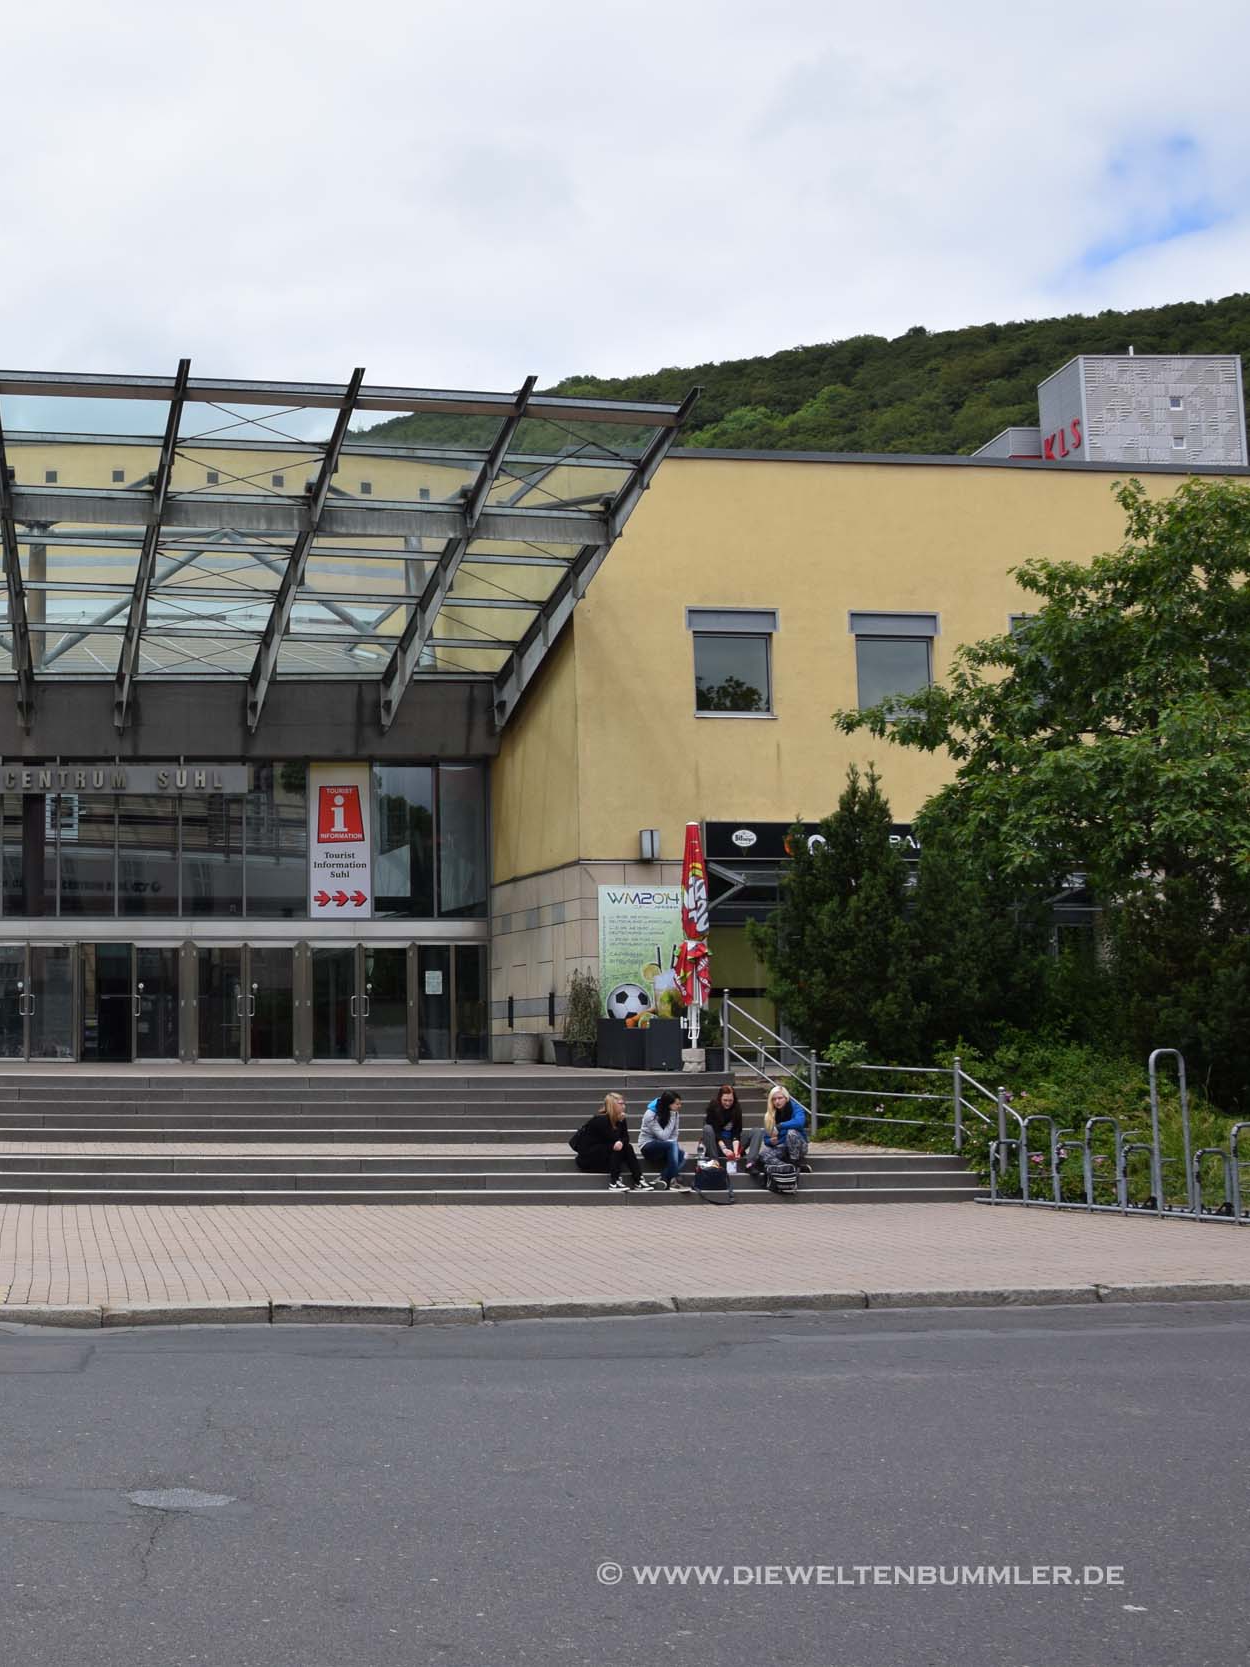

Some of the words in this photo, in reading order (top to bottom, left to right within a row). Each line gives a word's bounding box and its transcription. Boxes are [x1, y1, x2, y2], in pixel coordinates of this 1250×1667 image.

[5, 770, 128, 790] CENTRUM
[157, 770, 223, 789] SUHL
[313, 860, 367, 869] Information
